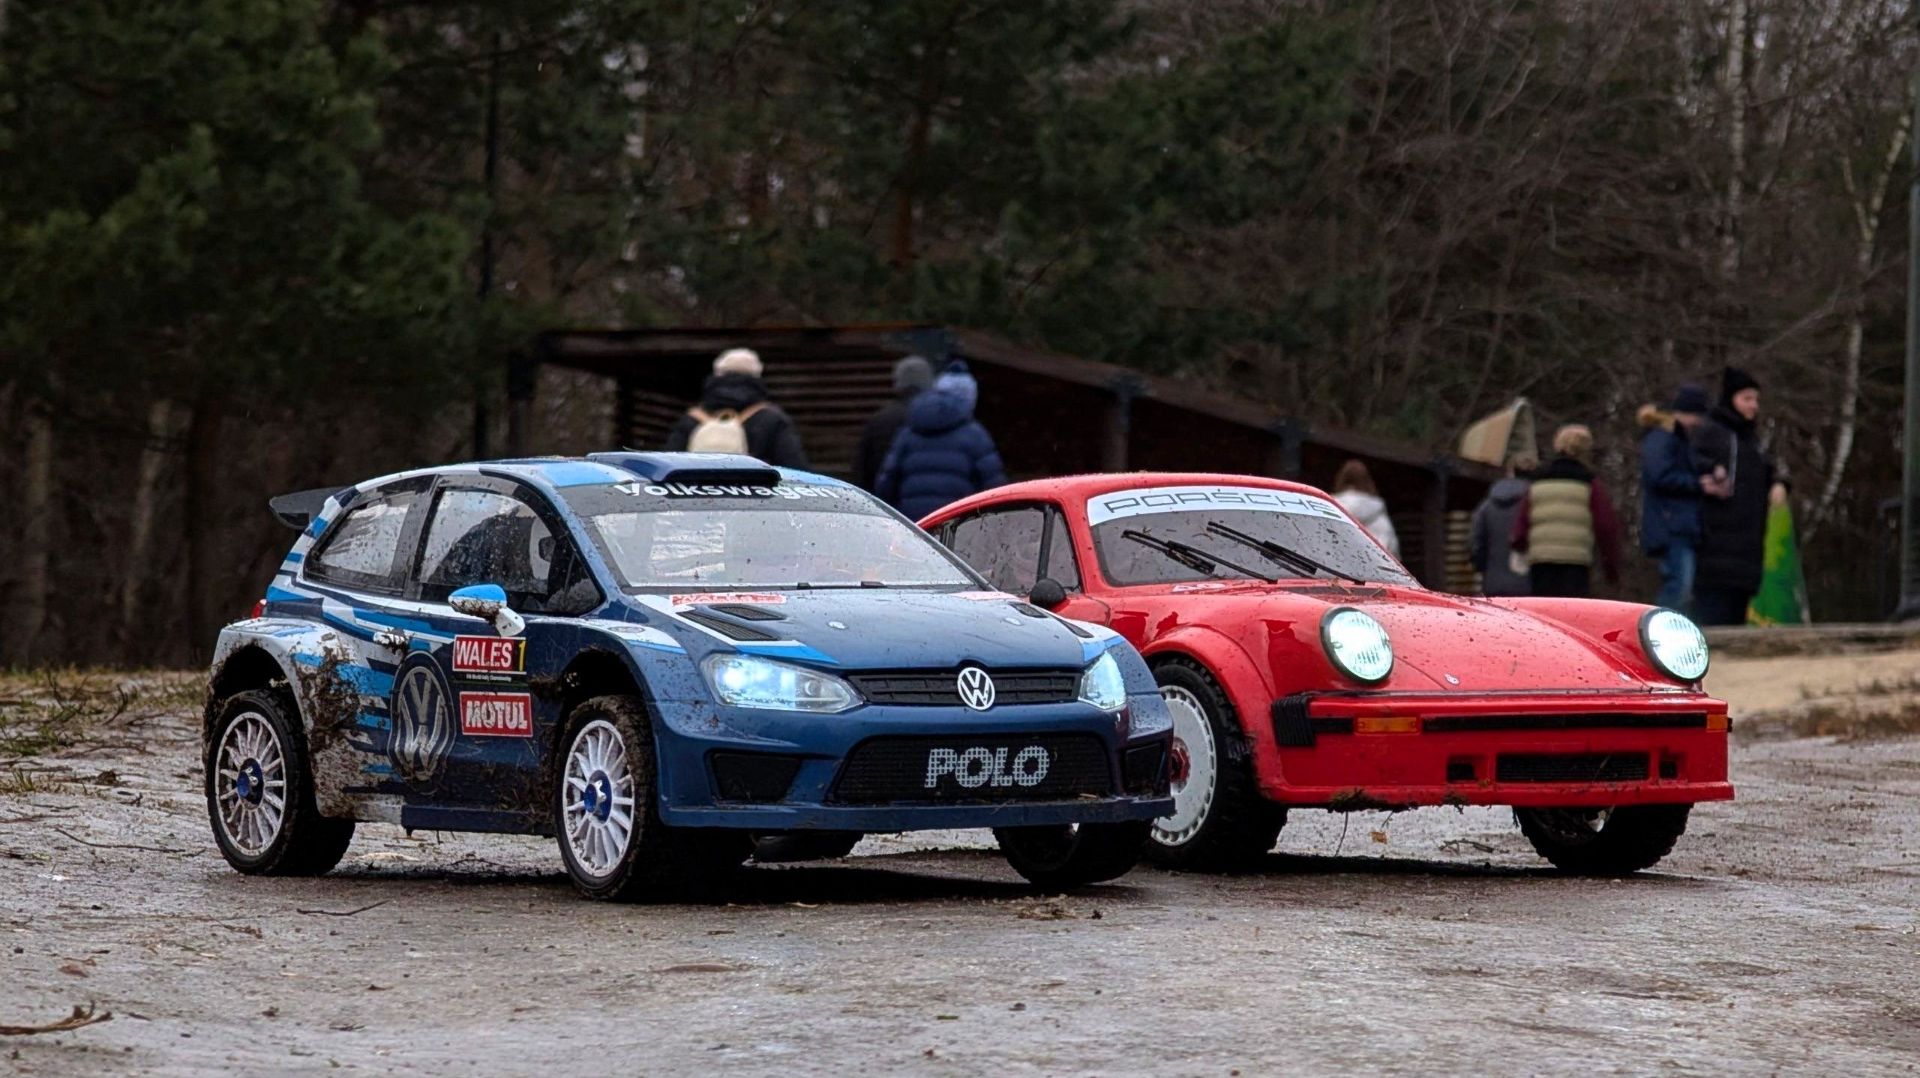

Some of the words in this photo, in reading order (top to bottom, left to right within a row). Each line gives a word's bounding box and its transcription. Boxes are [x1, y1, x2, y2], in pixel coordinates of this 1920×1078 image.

[614, 482, 841, 500] Volkswagen
[1104, 492, 1342, 519] PORSCHE
[456, 640, 513, 668] WALES
[518, 640, 526, 672] 1
[465, 700, 528, 730] MOTUL
[923, 746, 1050, 788] POLO
